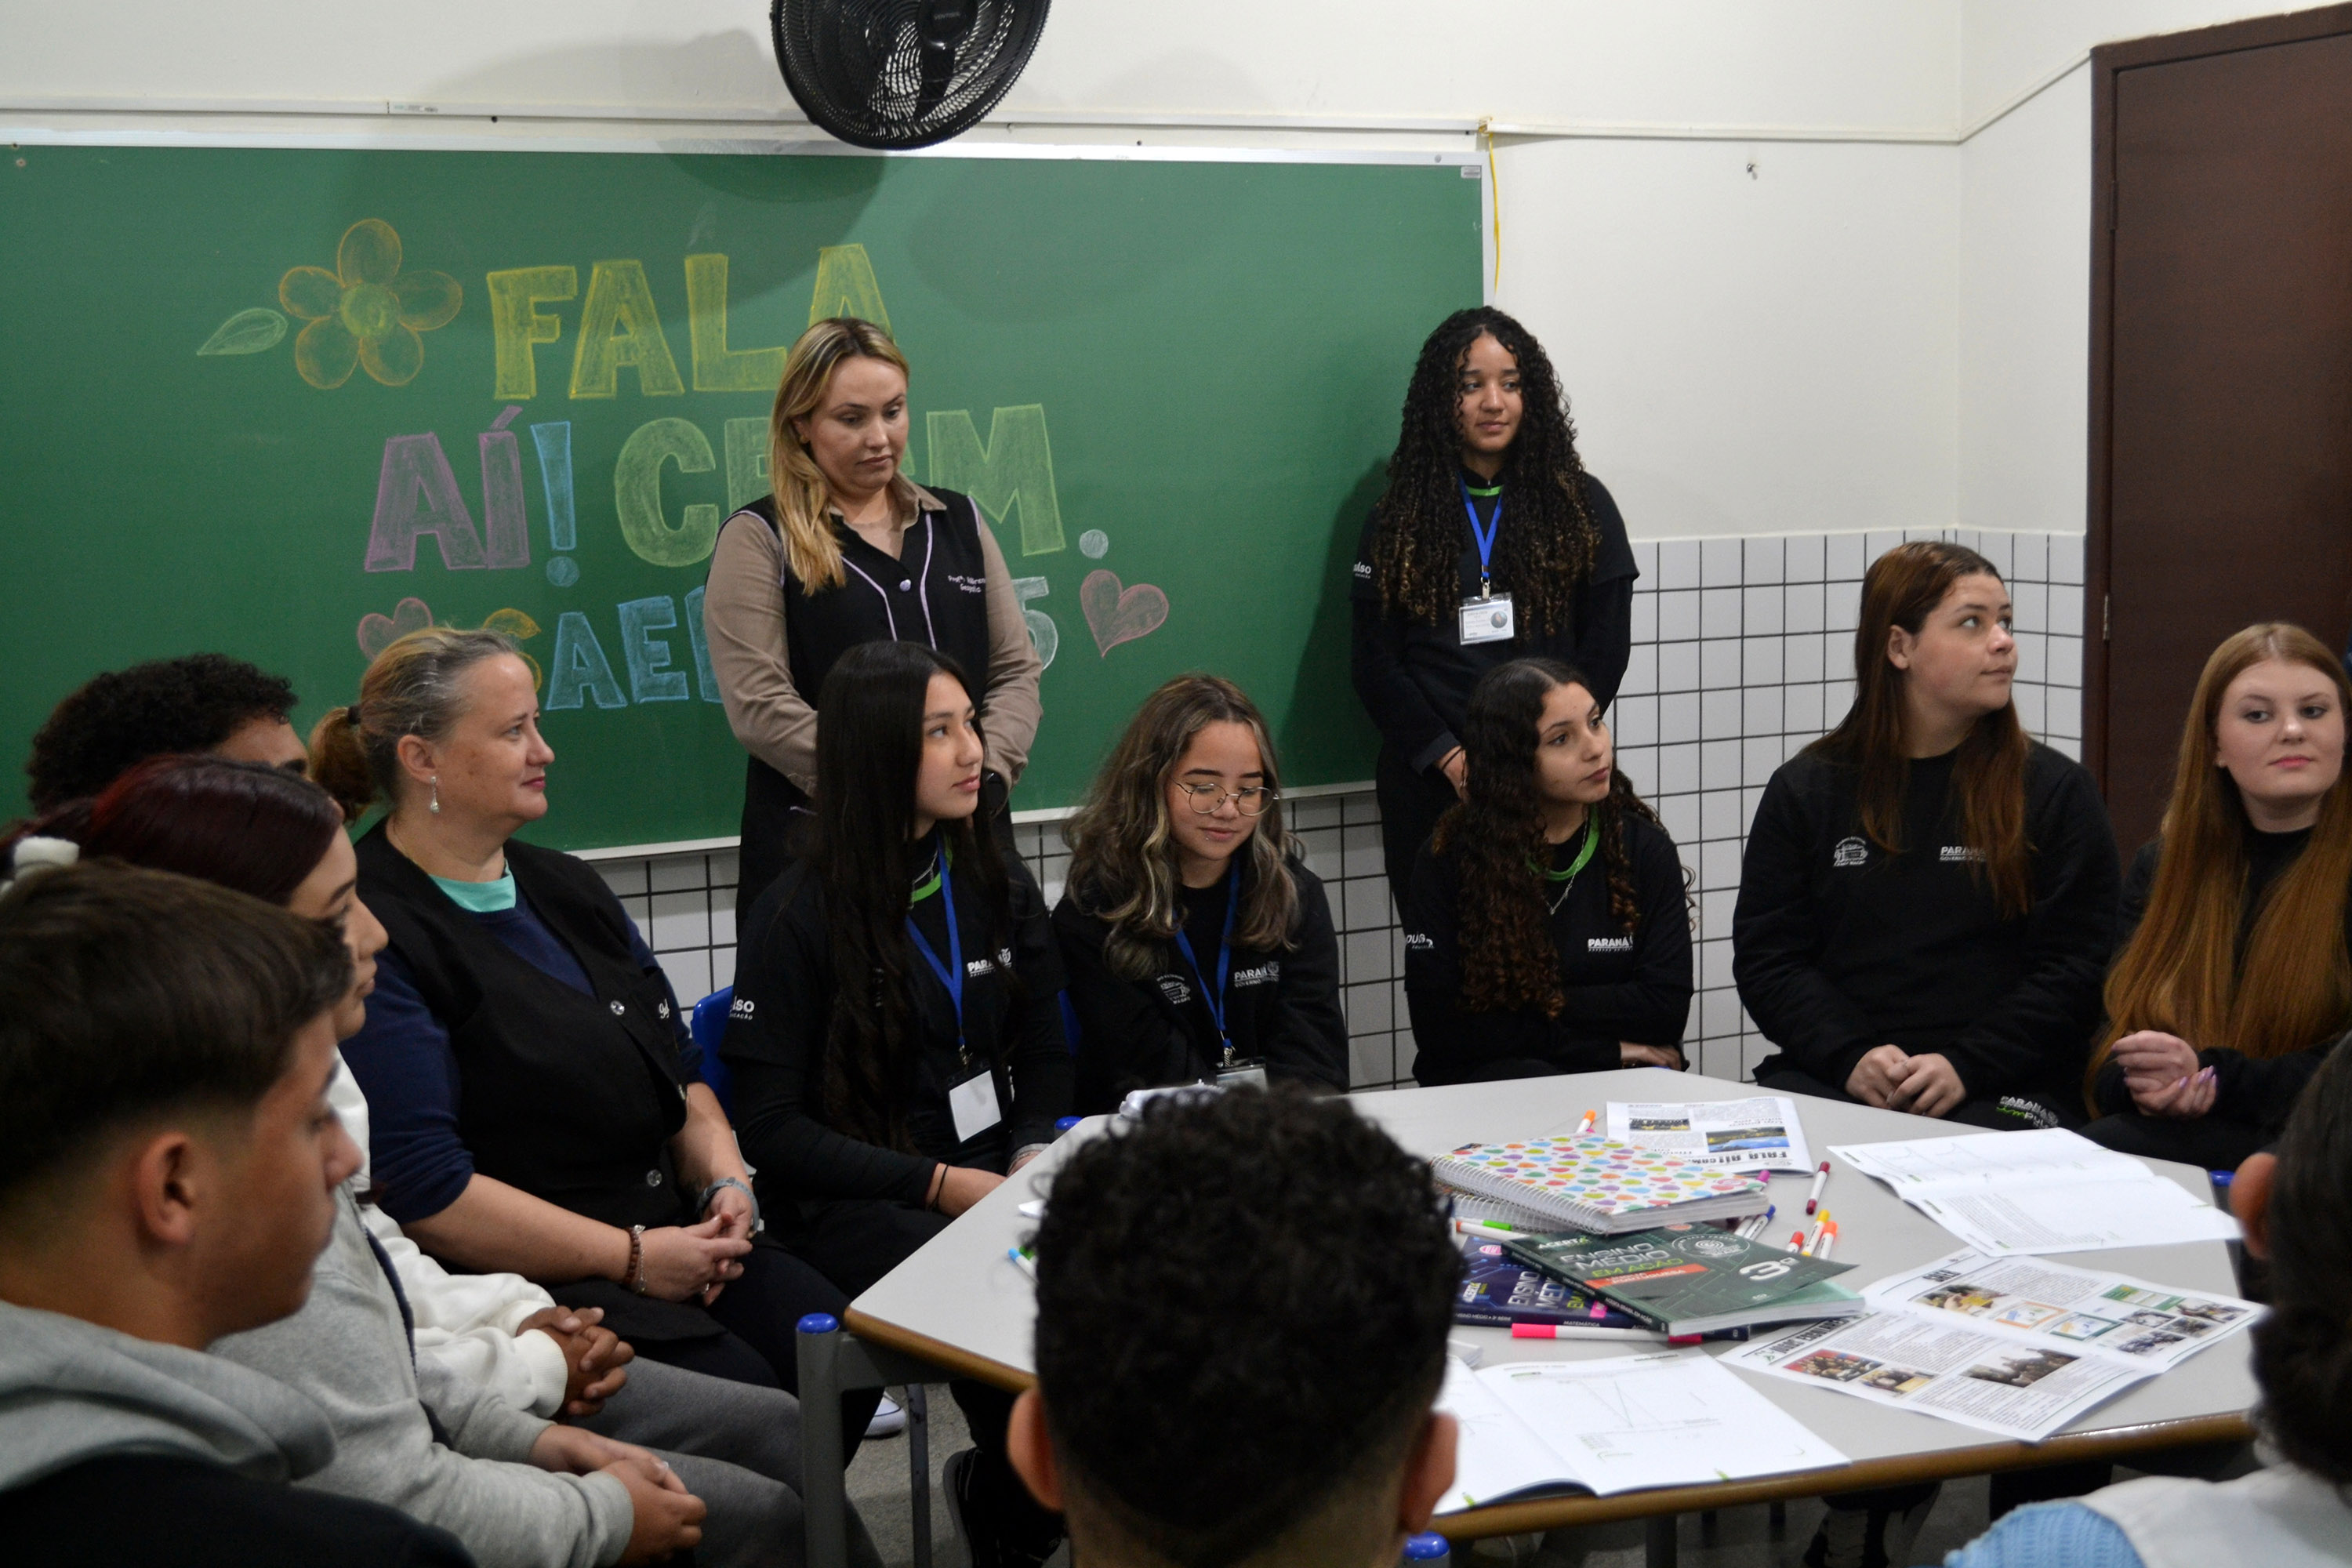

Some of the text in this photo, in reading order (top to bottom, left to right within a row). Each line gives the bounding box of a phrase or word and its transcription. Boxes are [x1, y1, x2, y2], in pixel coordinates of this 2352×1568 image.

[486, 243, 897, 399] FALA
[363, 405, 580, 587] AÍ!
[1560, 1242, 1655, 1263] ENSINO
[1508, 1271, 1541, 1306] ENSINO
[1592, 1267, 1624, 1279] EM
[1535, 1277, 1566, 1309] MÉDI
